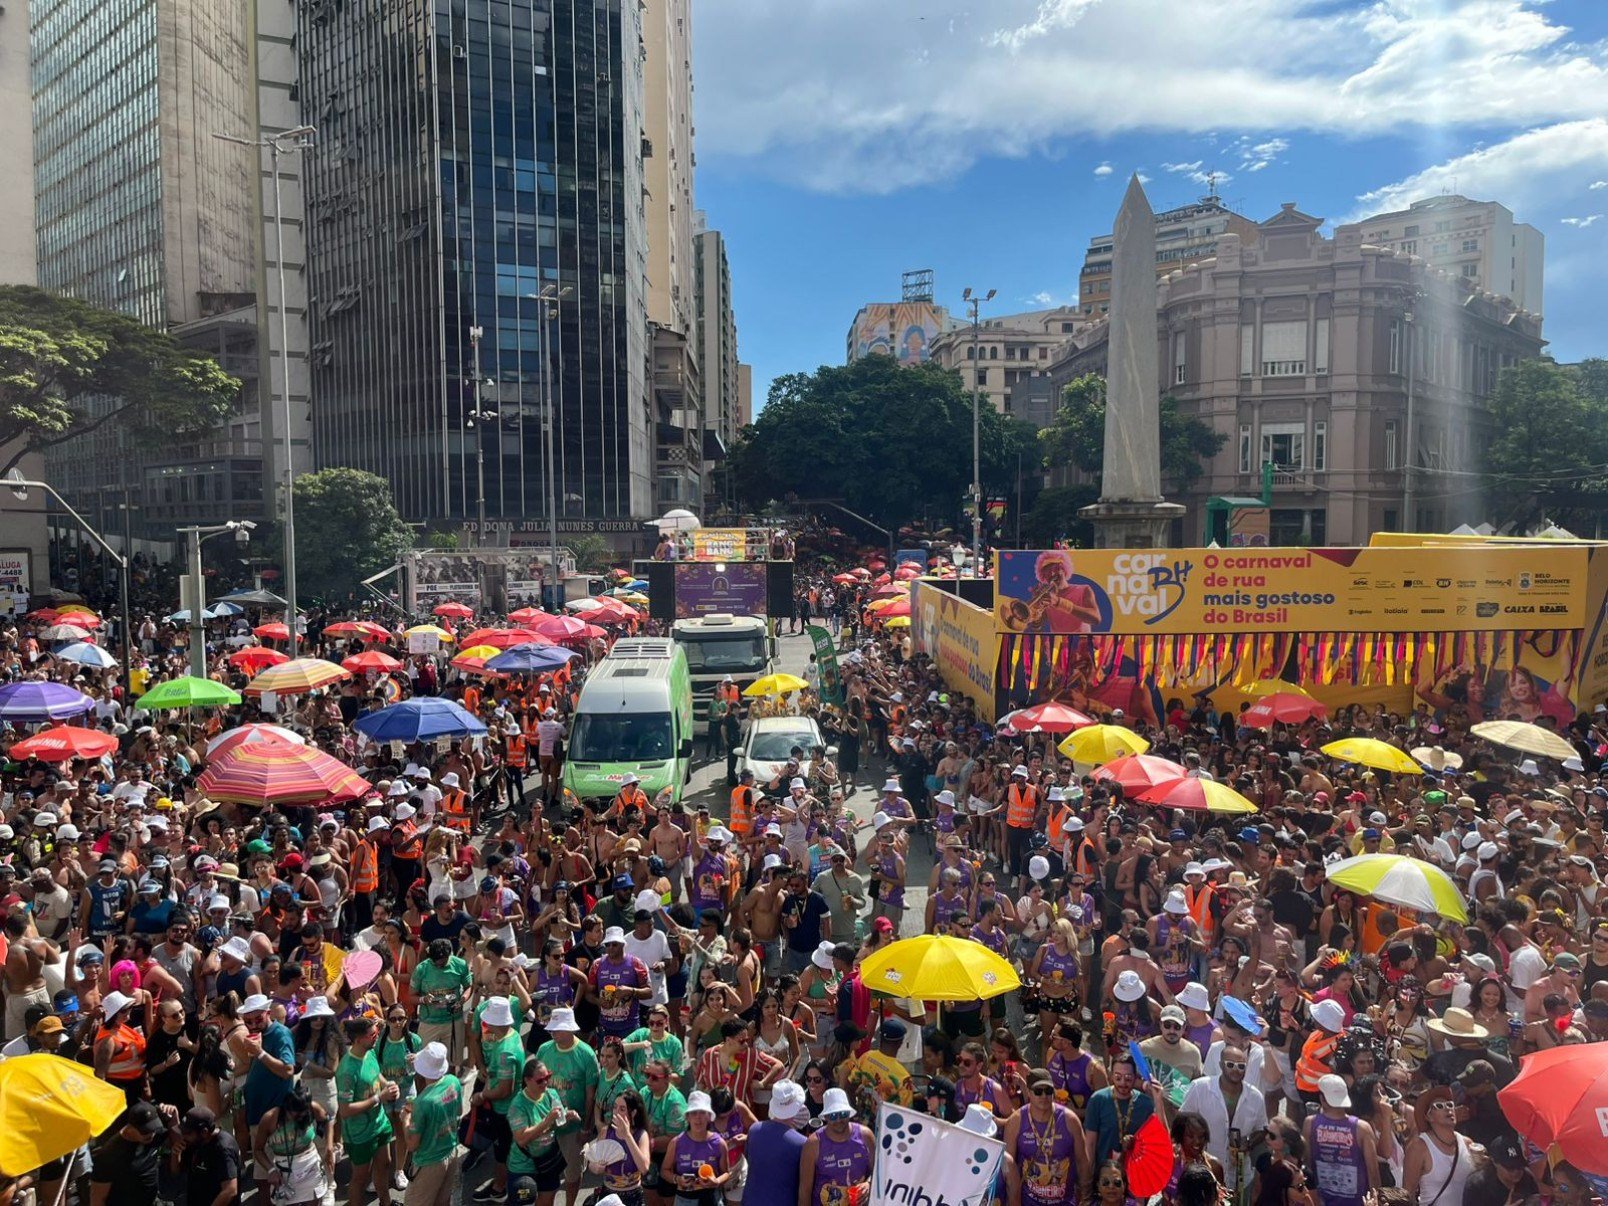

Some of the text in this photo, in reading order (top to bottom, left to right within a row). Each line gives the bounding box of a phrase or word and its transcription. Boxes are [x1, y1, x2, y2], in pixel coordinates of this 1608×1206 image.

[484, 522, 514, 532] DONA
[558, 522, 594, 532] NUNES
[598, 522, 639, 532] GUERRA
[1203, 553, 1312, 569] O carnaval
[1203, 573, 1266, 587] de rua
[1203, 591, 1335, 609] mais gostoso
[1203, 608, 1288, 624] do Brasil
